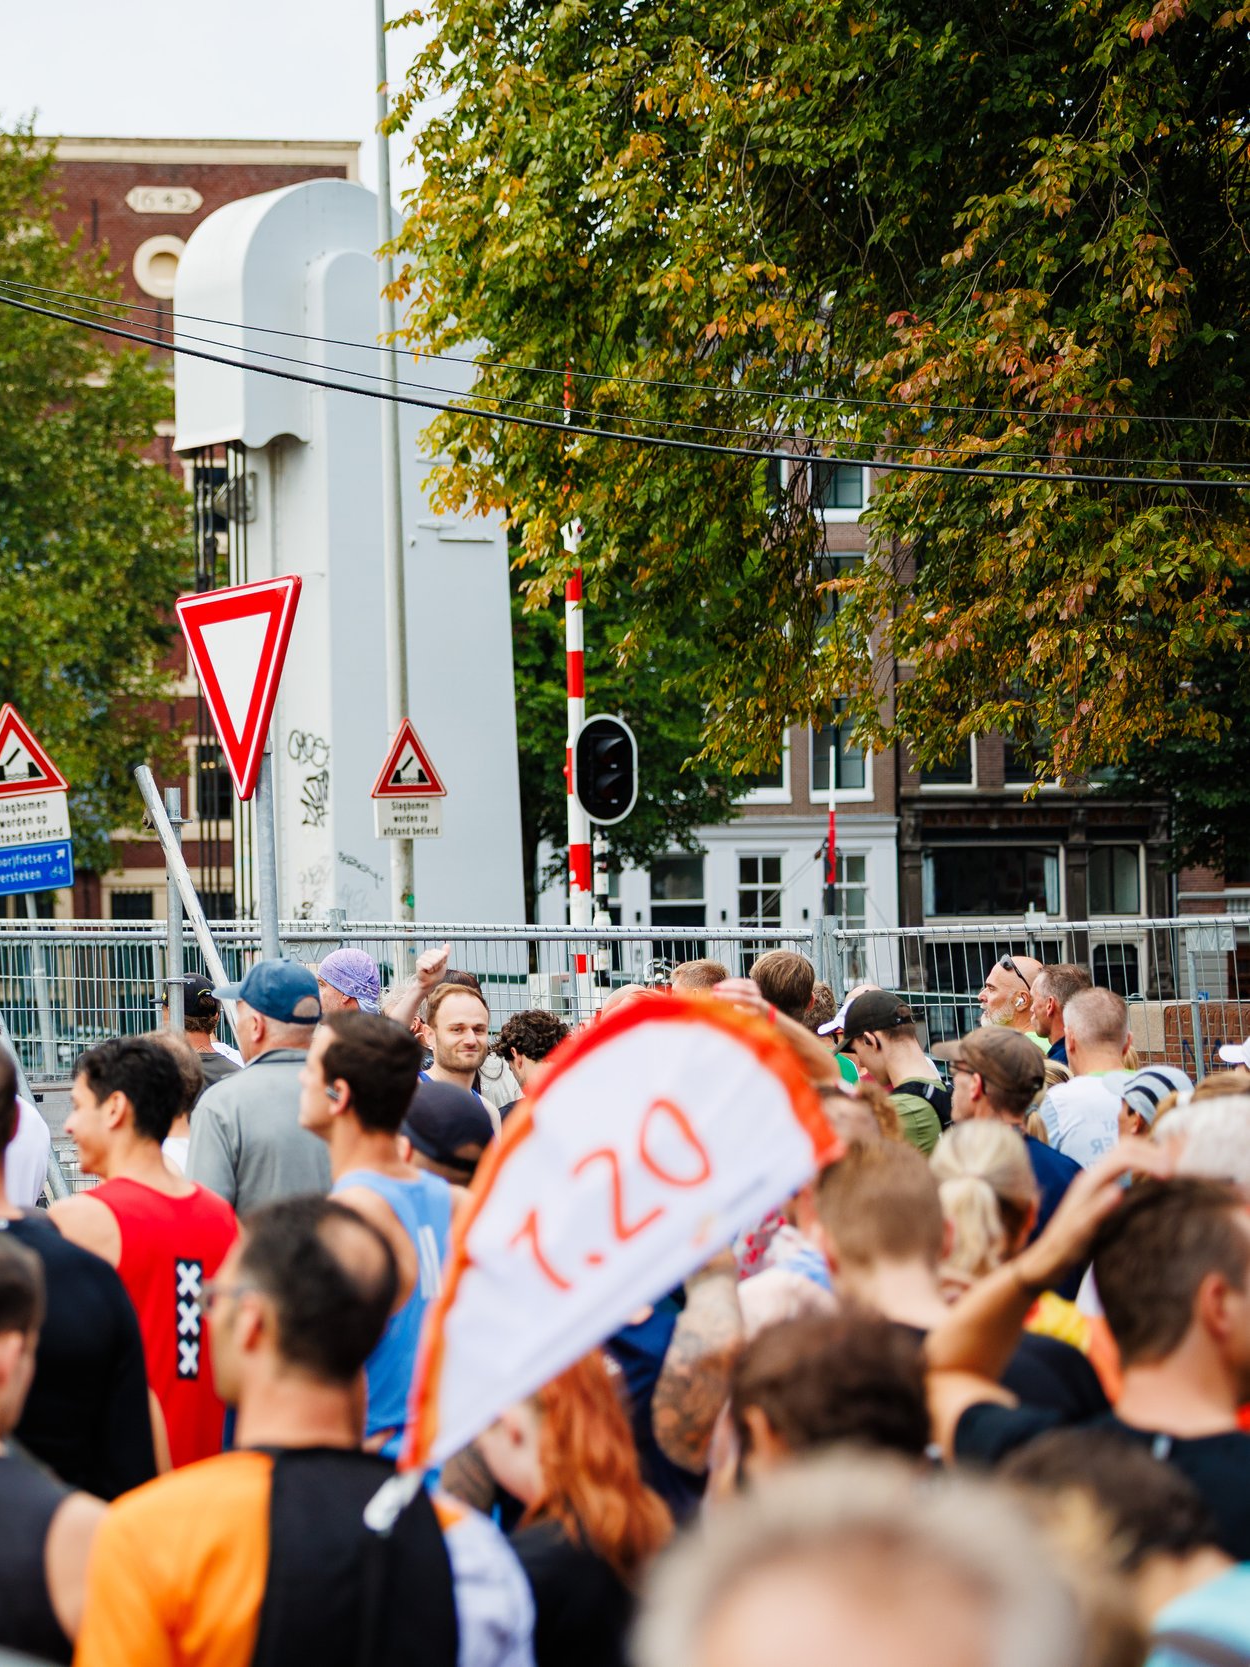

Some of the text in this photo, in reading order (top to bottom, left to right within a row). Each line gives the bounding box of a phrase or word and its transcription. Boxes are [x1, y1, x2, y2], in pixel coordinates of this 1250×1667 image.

[391, 801, 430, 812] Slagbomen
[0, 815, 48, 828] worden op
[393, 815, 428, 823] worden op
[25, 827, 64, 841] bediend
[383, 826, 439, 836] afstand bediend
